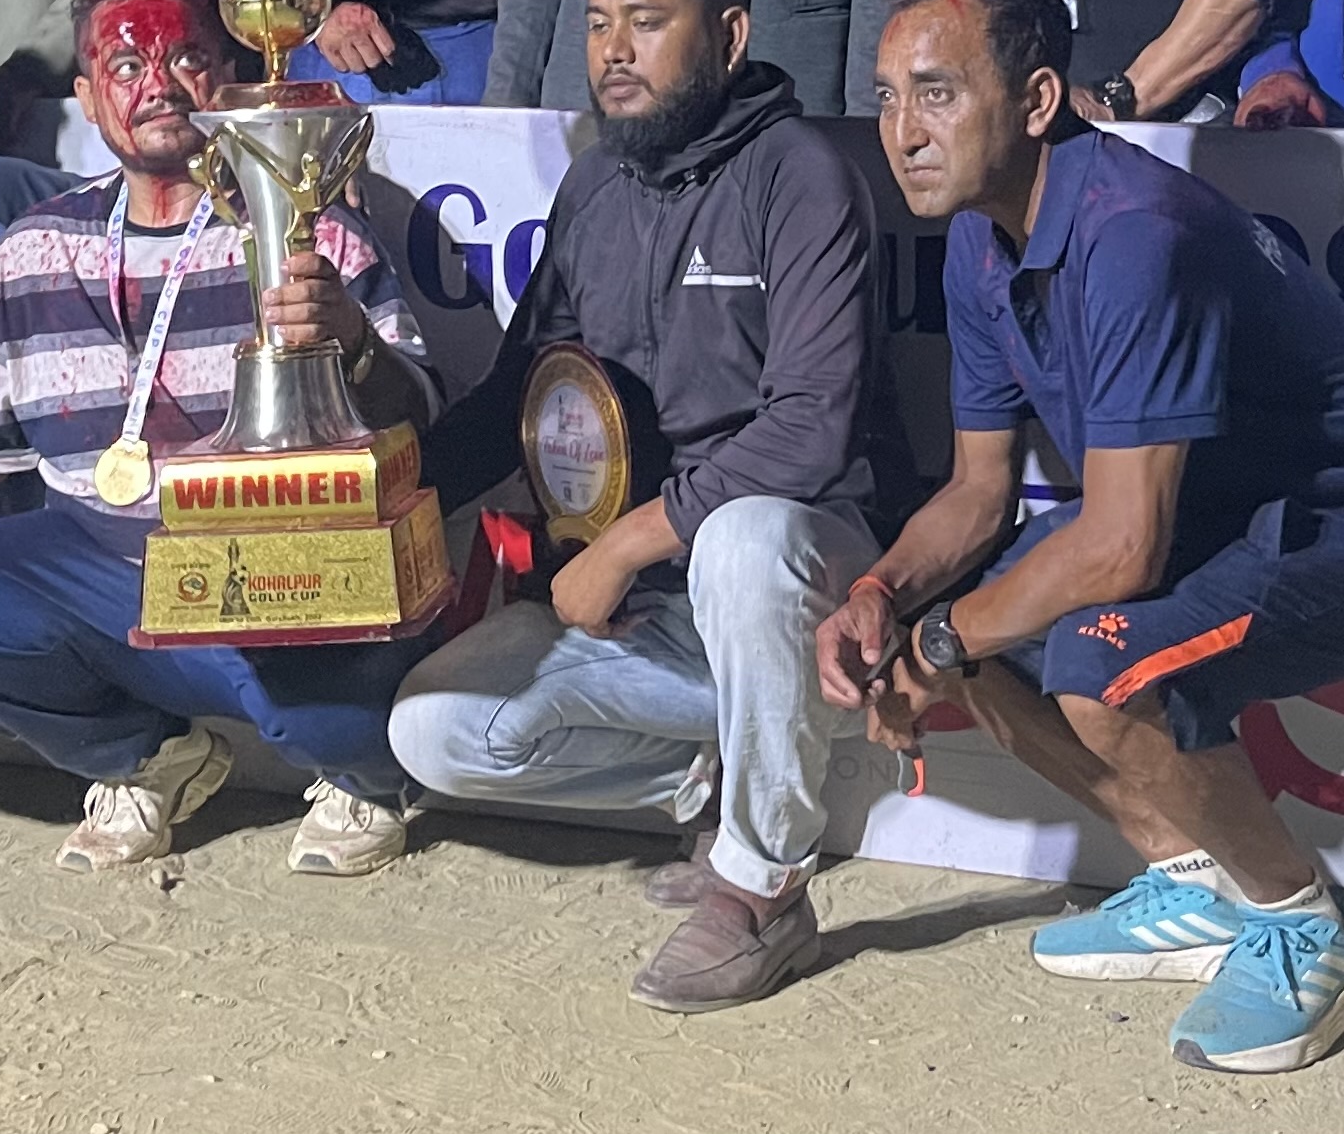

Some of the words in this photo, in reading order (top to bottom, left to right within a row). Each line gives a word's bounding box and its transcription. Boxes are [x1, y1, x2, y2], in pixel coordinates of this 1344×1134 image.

[408, 183, 547, 310] Go
[172, 470, 363, 511] WINNER
[248, 573, 322, 592] KOHALPUR
[248, 591, 288, 603] GOLD
[291, 590, 321, 602] CUP
